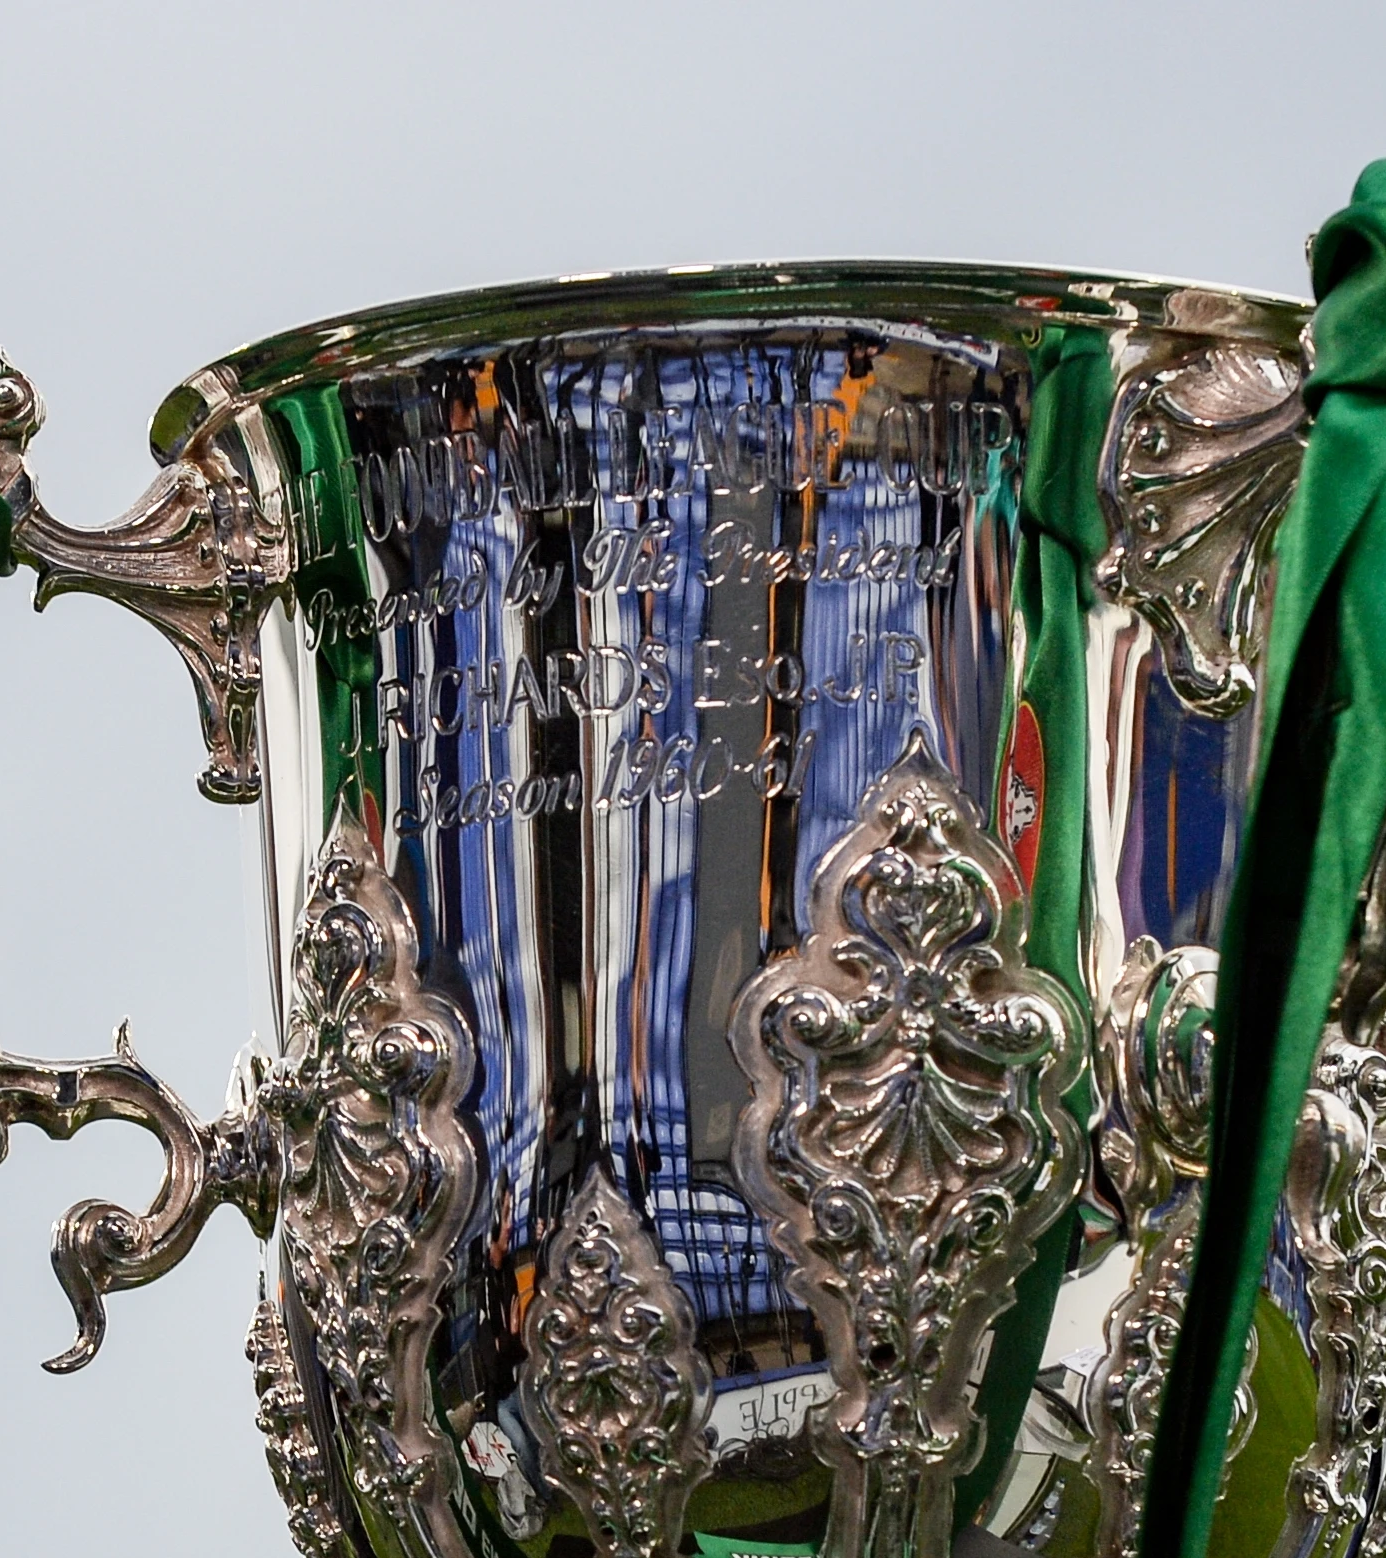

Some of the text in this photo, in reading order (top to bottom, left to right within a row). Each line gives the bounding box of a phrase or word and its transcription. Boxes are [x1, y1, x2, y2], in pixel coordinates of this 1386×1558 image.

[285, 398, 1015, 573] HE FOOTBALL LEAGUE CUP
[305, 518, 964, 651] Presented by The President
[376, 638, 673, 750] RICHARDS
[392, 727, 816, 838] Season 1960-61
